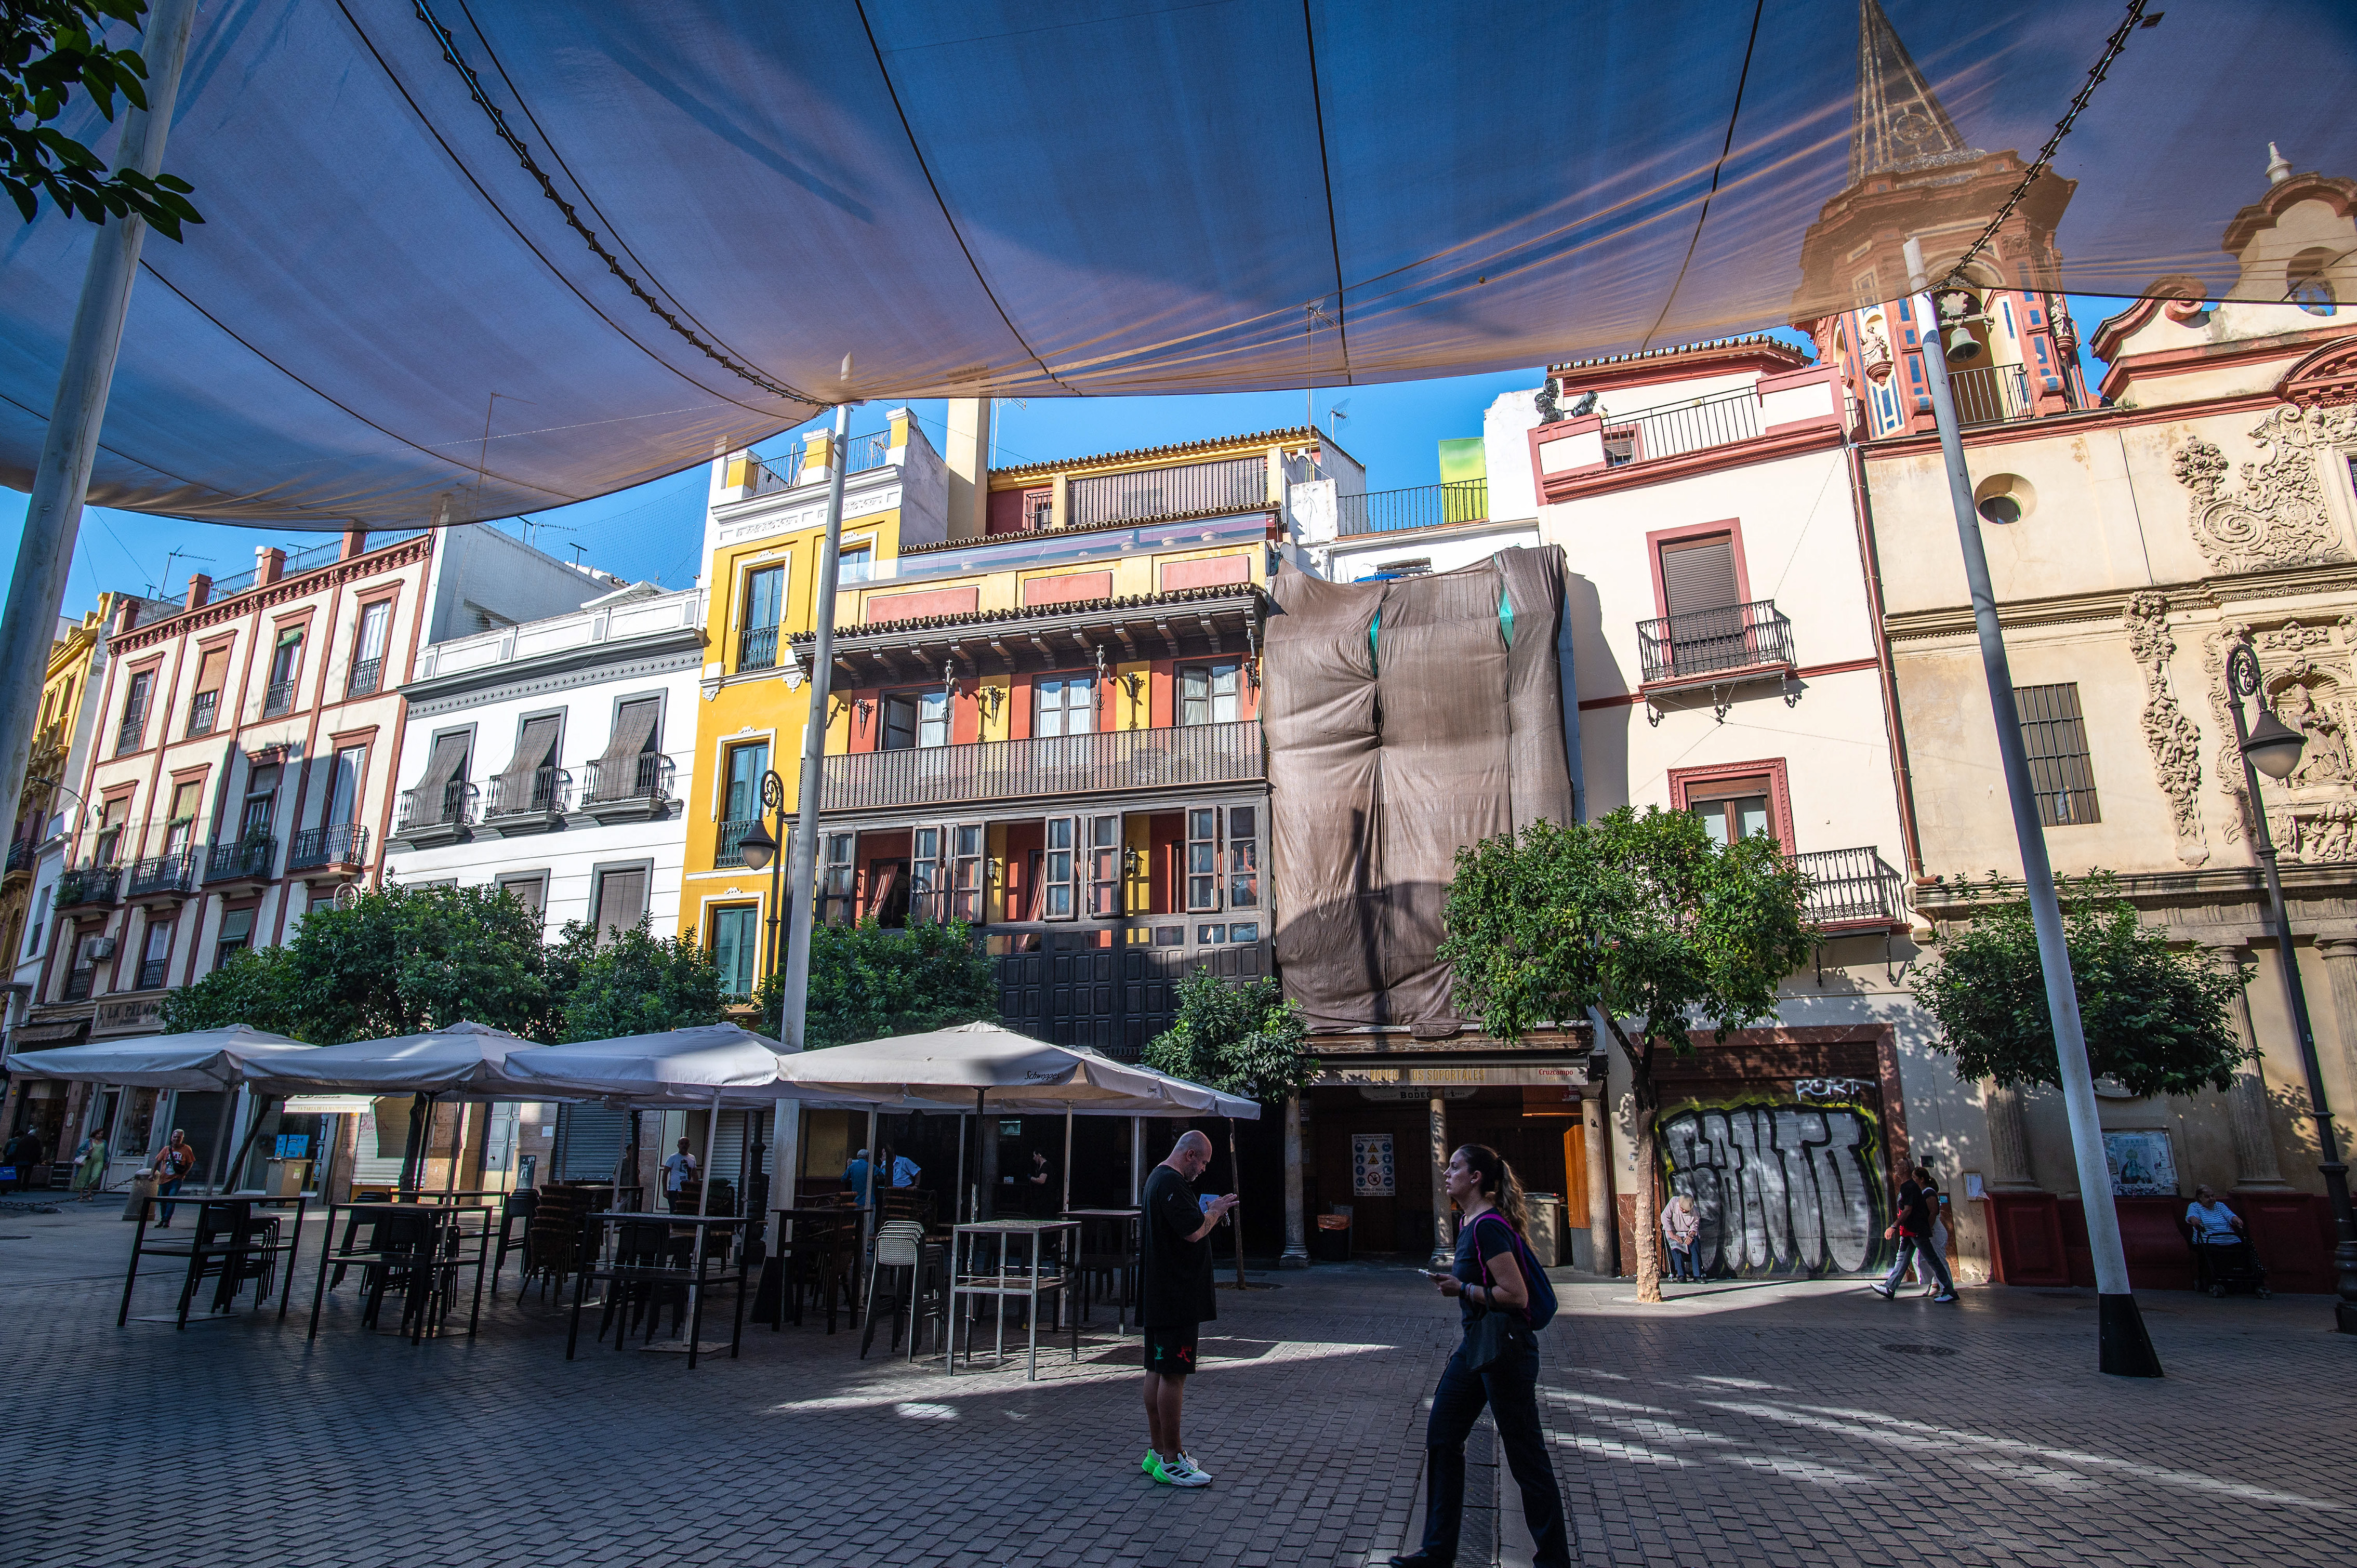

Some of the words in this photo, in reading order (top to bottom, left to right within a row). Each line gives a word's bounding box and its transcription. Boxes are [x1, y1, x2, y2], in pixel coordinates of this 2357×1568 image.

[107, 1007, 119, 1018] LA
[1024, 1070, 1061, 1081] Schweppes
[1407, 1069, 1424, 1081] LOS
[1427, 1069, 1485, 1081] SOPORTALES
